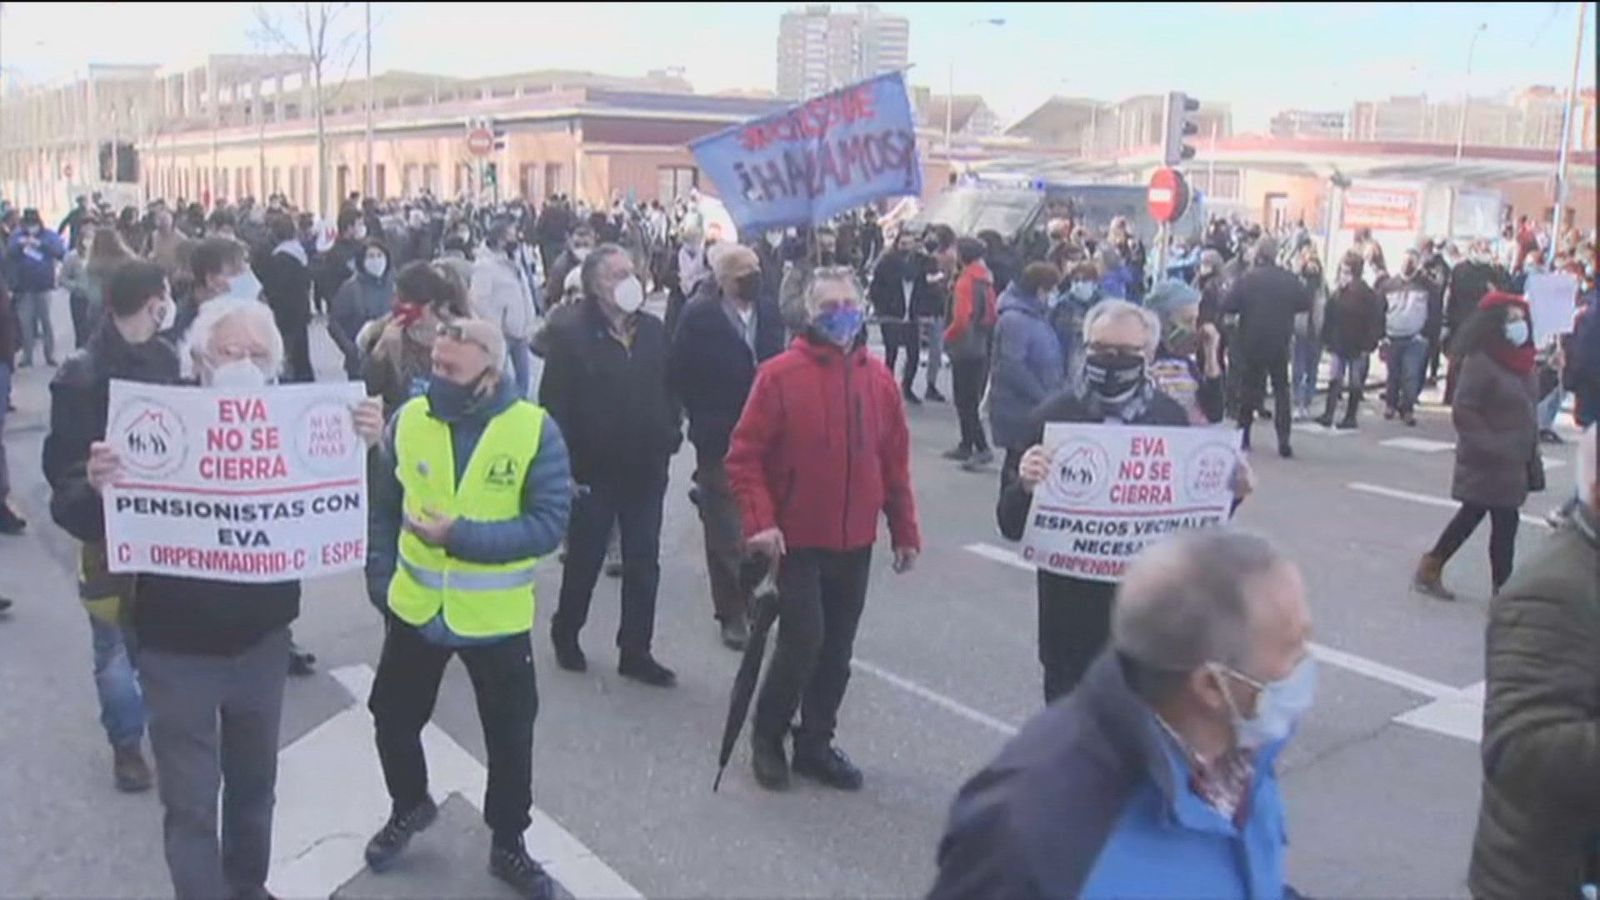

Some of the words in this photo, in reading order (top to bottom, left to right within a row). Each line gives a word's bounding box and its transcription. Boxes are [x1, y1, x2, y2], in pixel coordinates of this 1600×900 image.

[218, 399, 267, 423] EVA
[206, 428, 243, 452] NO
[250, 427, 279, 450] SE
[1130, 437, 1165, 456] EVA
[198, 455, 288, 480] CIERRA
[1118, 461, 1143, 480] NO
[1149, 461, 1173, 480] SE
[1109, 484, 1173, 505] CIERRA
[116, 496, 305, 521] PENSIONISTAS
[311, 493, 360, 515] CON
[1034, 514, 1128, 536] ESPACIOS
[218, 529, 271, 547] EVA
